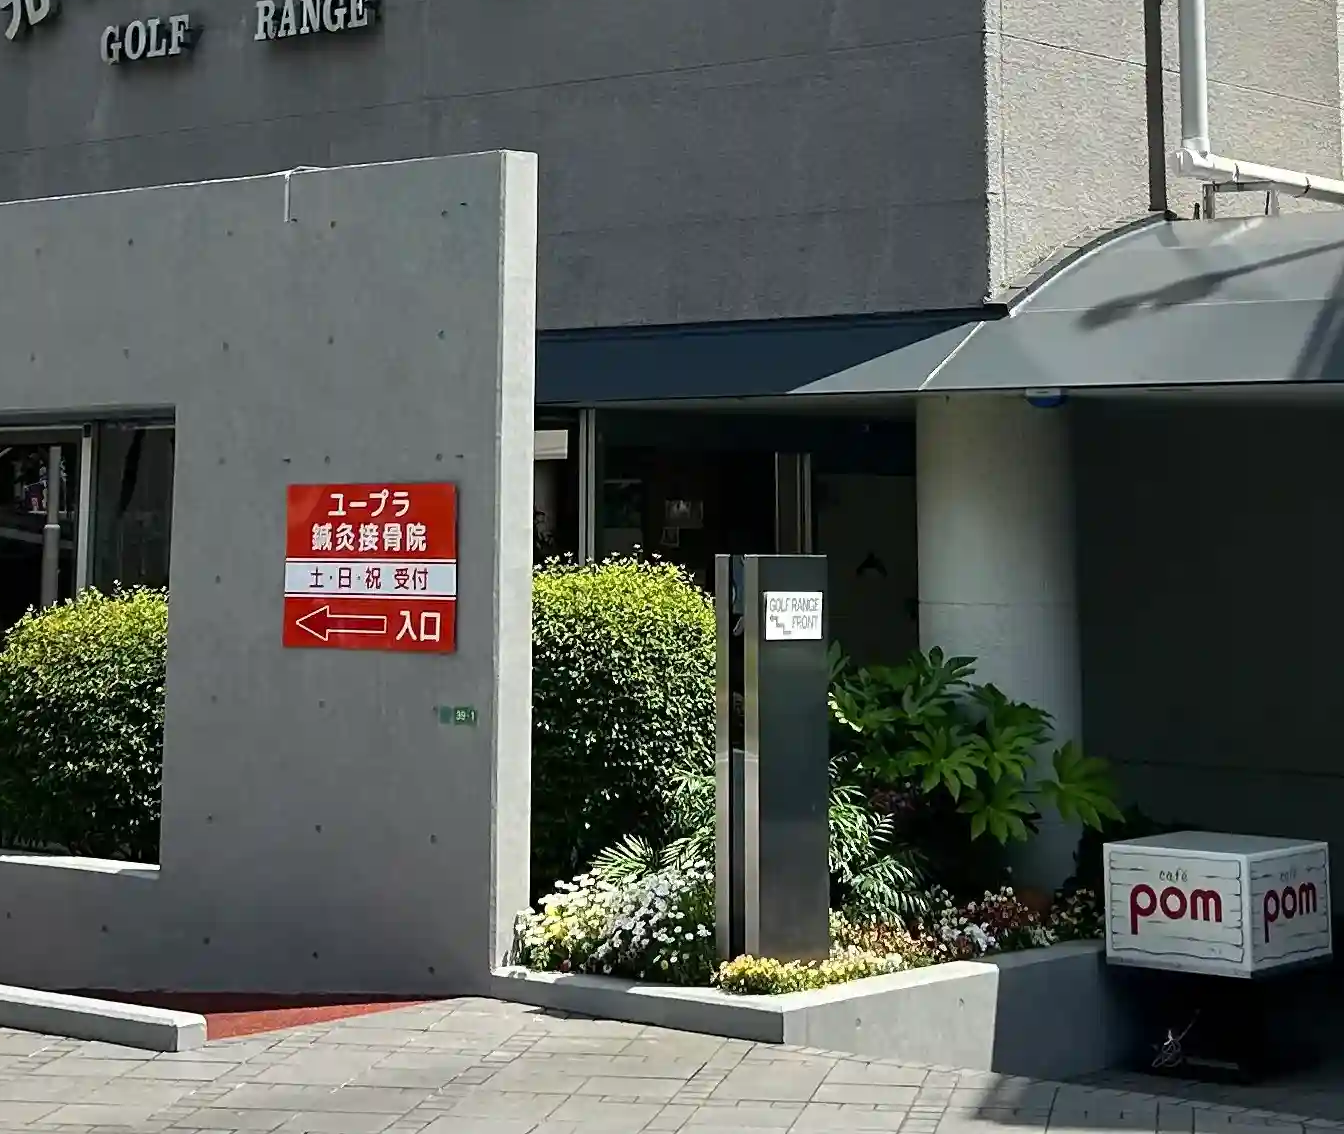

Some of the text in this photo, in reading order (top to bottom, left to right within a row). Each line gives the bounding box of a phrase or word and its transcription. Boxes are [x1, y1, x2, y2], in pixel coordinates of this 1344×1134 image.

[100, 14, 191, 65] GOLF
[328, 489, 411, 517] ユープラ
[312, 522, 427, 552] 鍼灸接骨院
[394, 568, 429, 591] 受付
[769, 597, 819, 612] GOLF RANGE
[396, 610, 441, 642] 入口
[792, 615, 819, 629] FRONT
[1130, 883, 1222, 935] pom
[1264, 882, 1317, 943] pom
